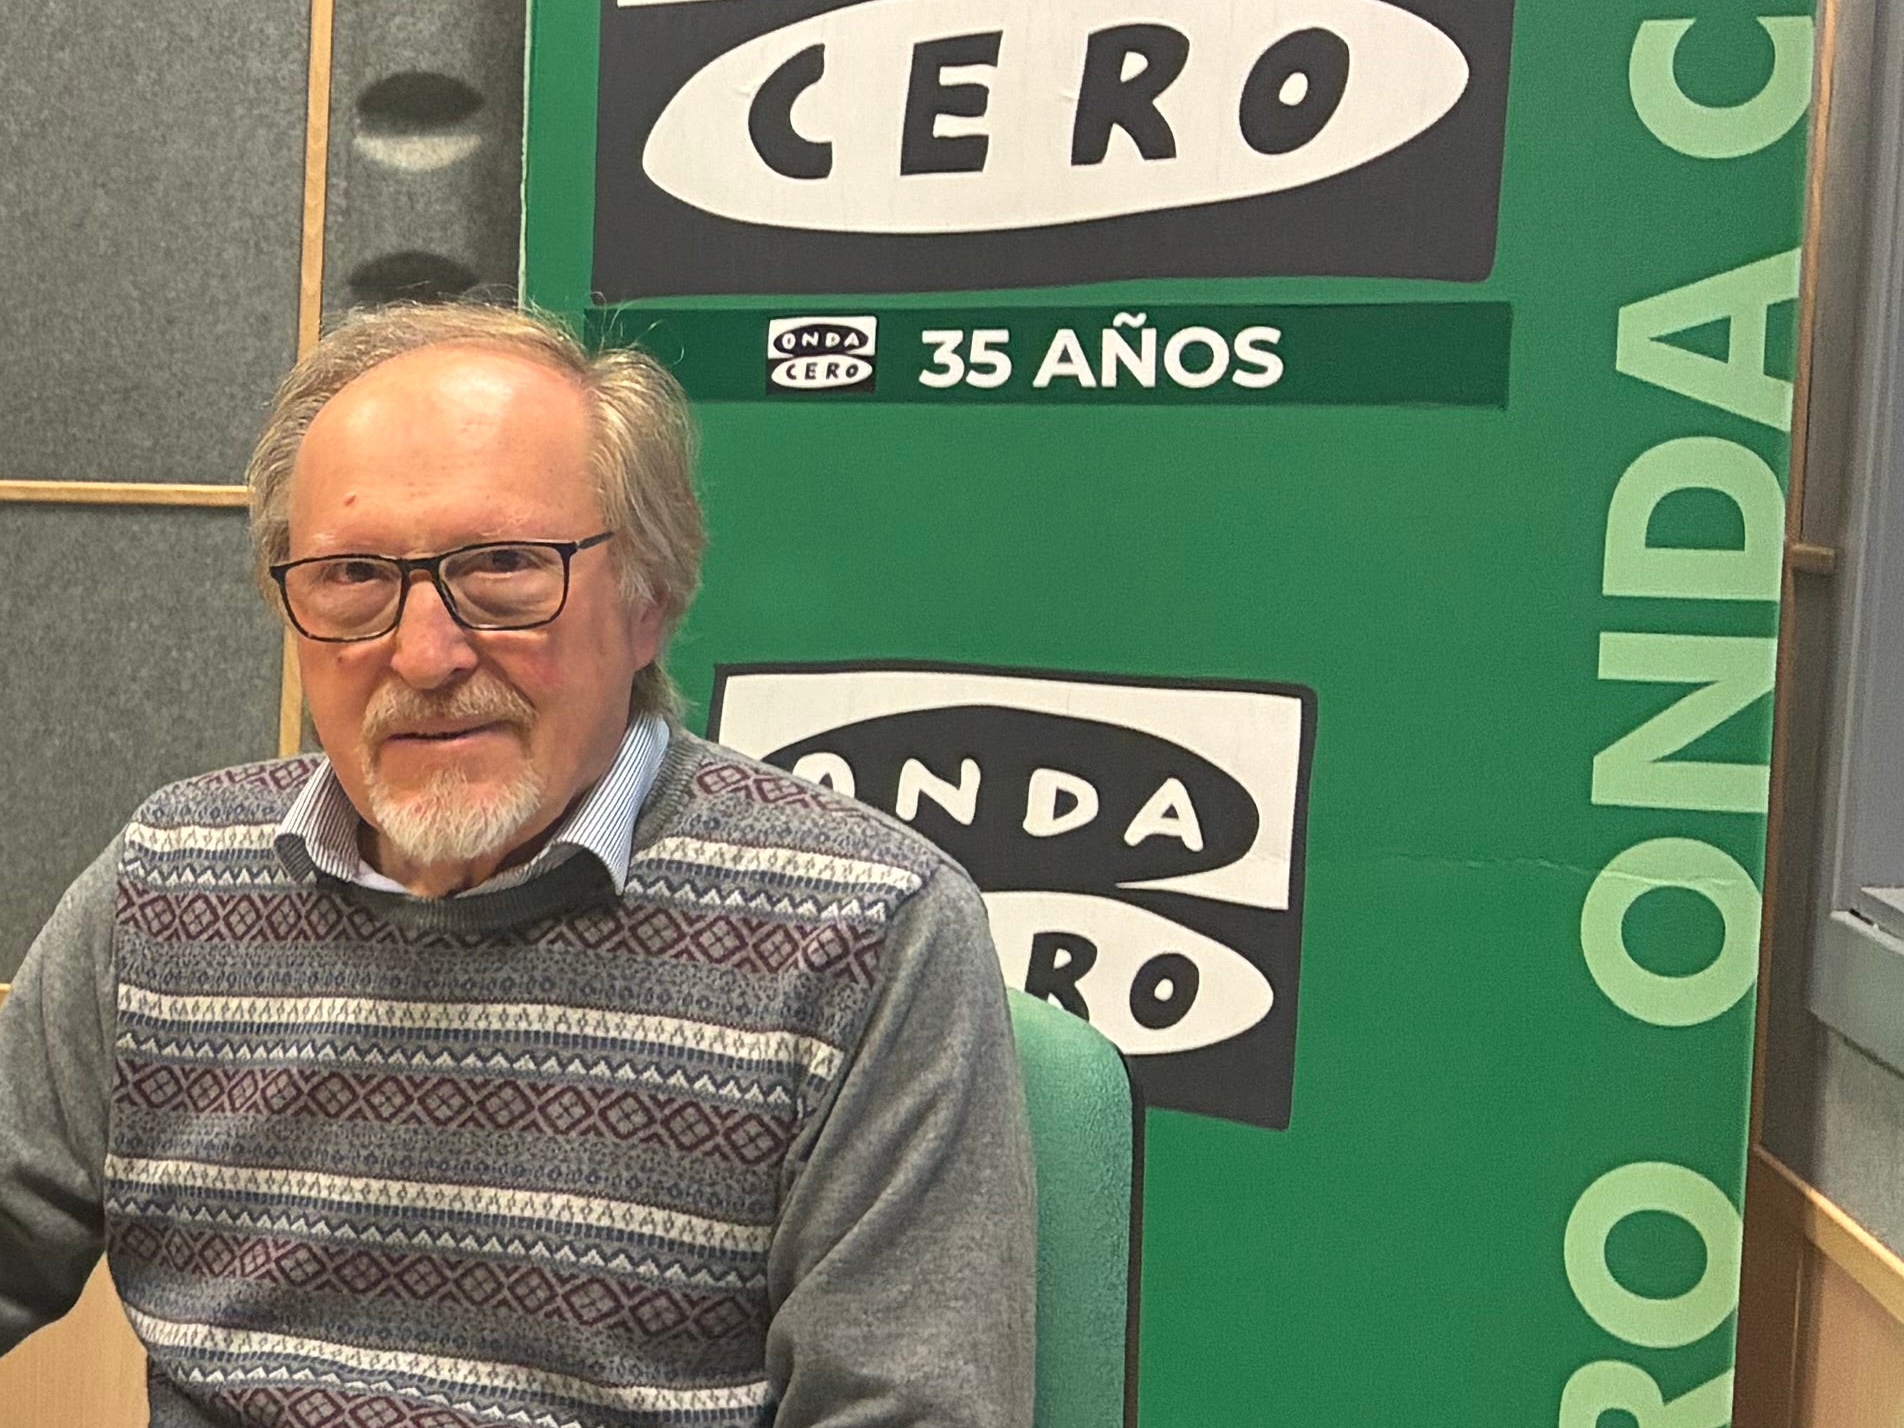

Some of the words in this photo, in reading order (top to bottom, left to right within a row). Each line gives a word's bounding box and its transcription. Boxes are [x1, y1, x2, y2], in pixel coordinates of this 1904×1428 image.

[747, 20, 1351, 180] CERO
[777, 330, 860, 350] ONDA
[785, 362, 860, 382] CERO
[918, 329, 1012, 389] 35
[1032, 311, 1284, 389] AÑOS
[1580, 246, 1803, 1027] ONDA
[1025, 931, 1200, 1031] RO
